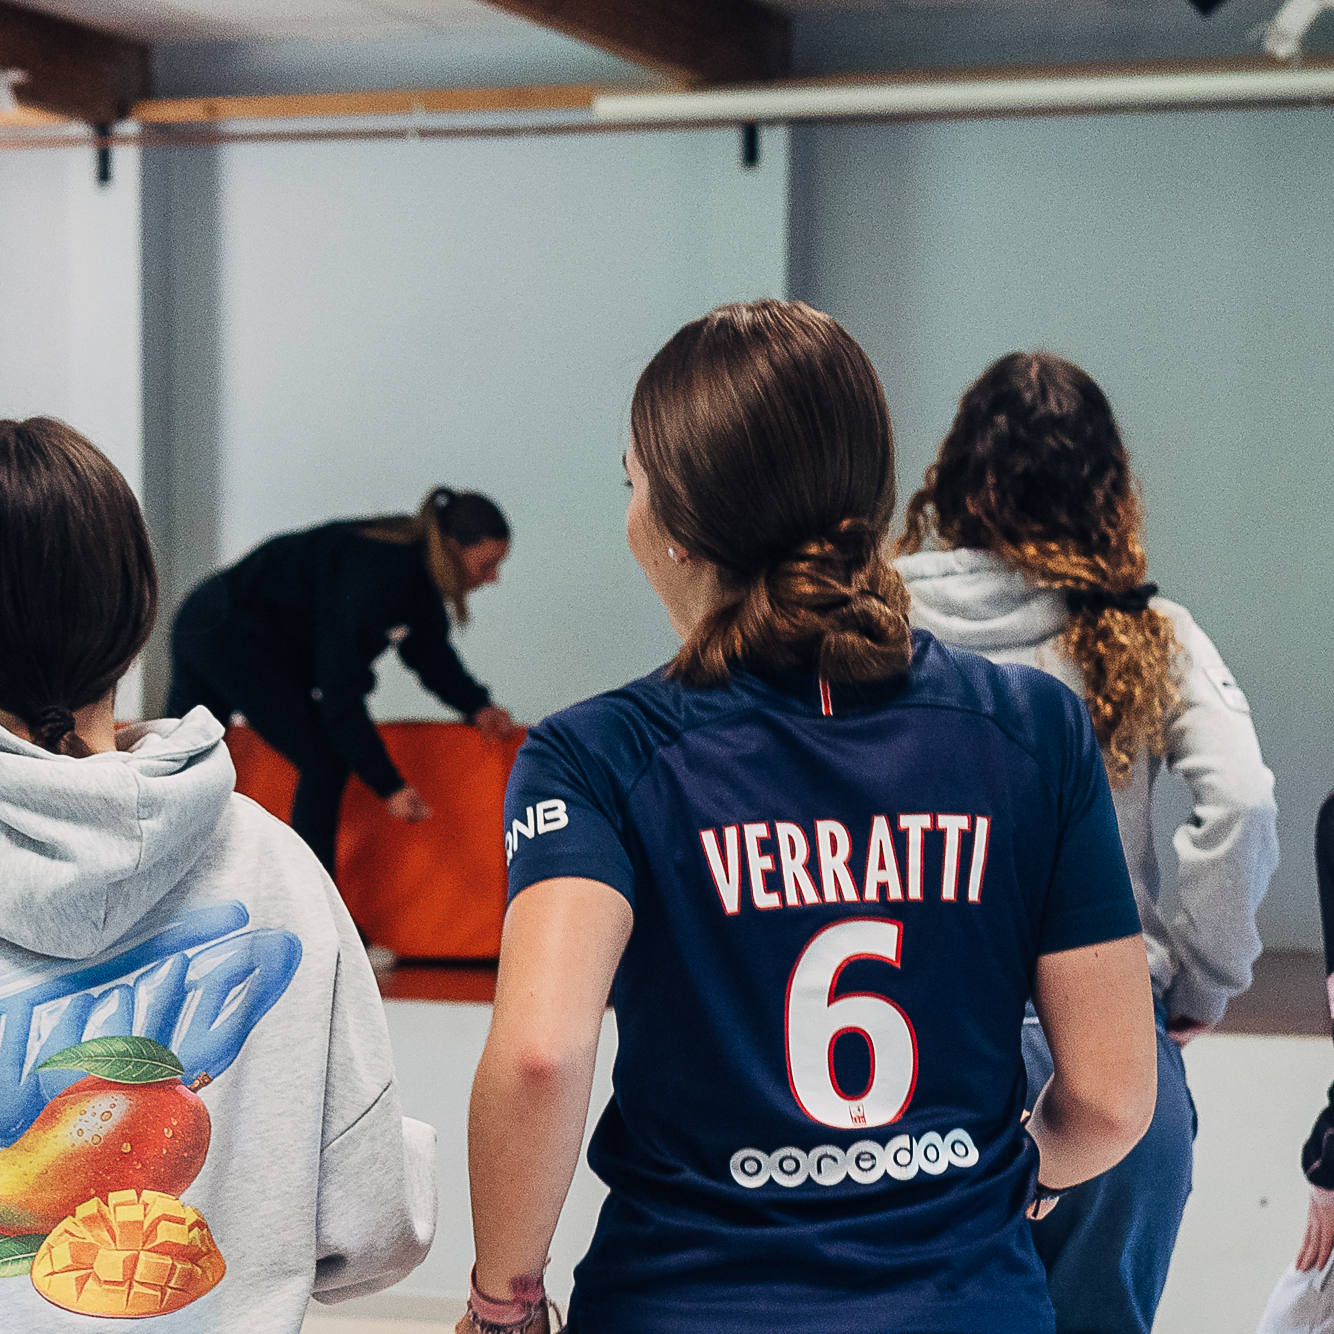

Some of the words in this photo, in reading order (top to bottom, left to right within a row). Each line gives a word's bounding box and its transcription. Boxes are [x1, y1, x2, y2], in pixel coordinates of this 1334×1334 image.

[699, 811, 992, 917] VERRATTI
[783, 915, 920, 1130] 6
[729, 1127, 980, 1190] ooredoo
